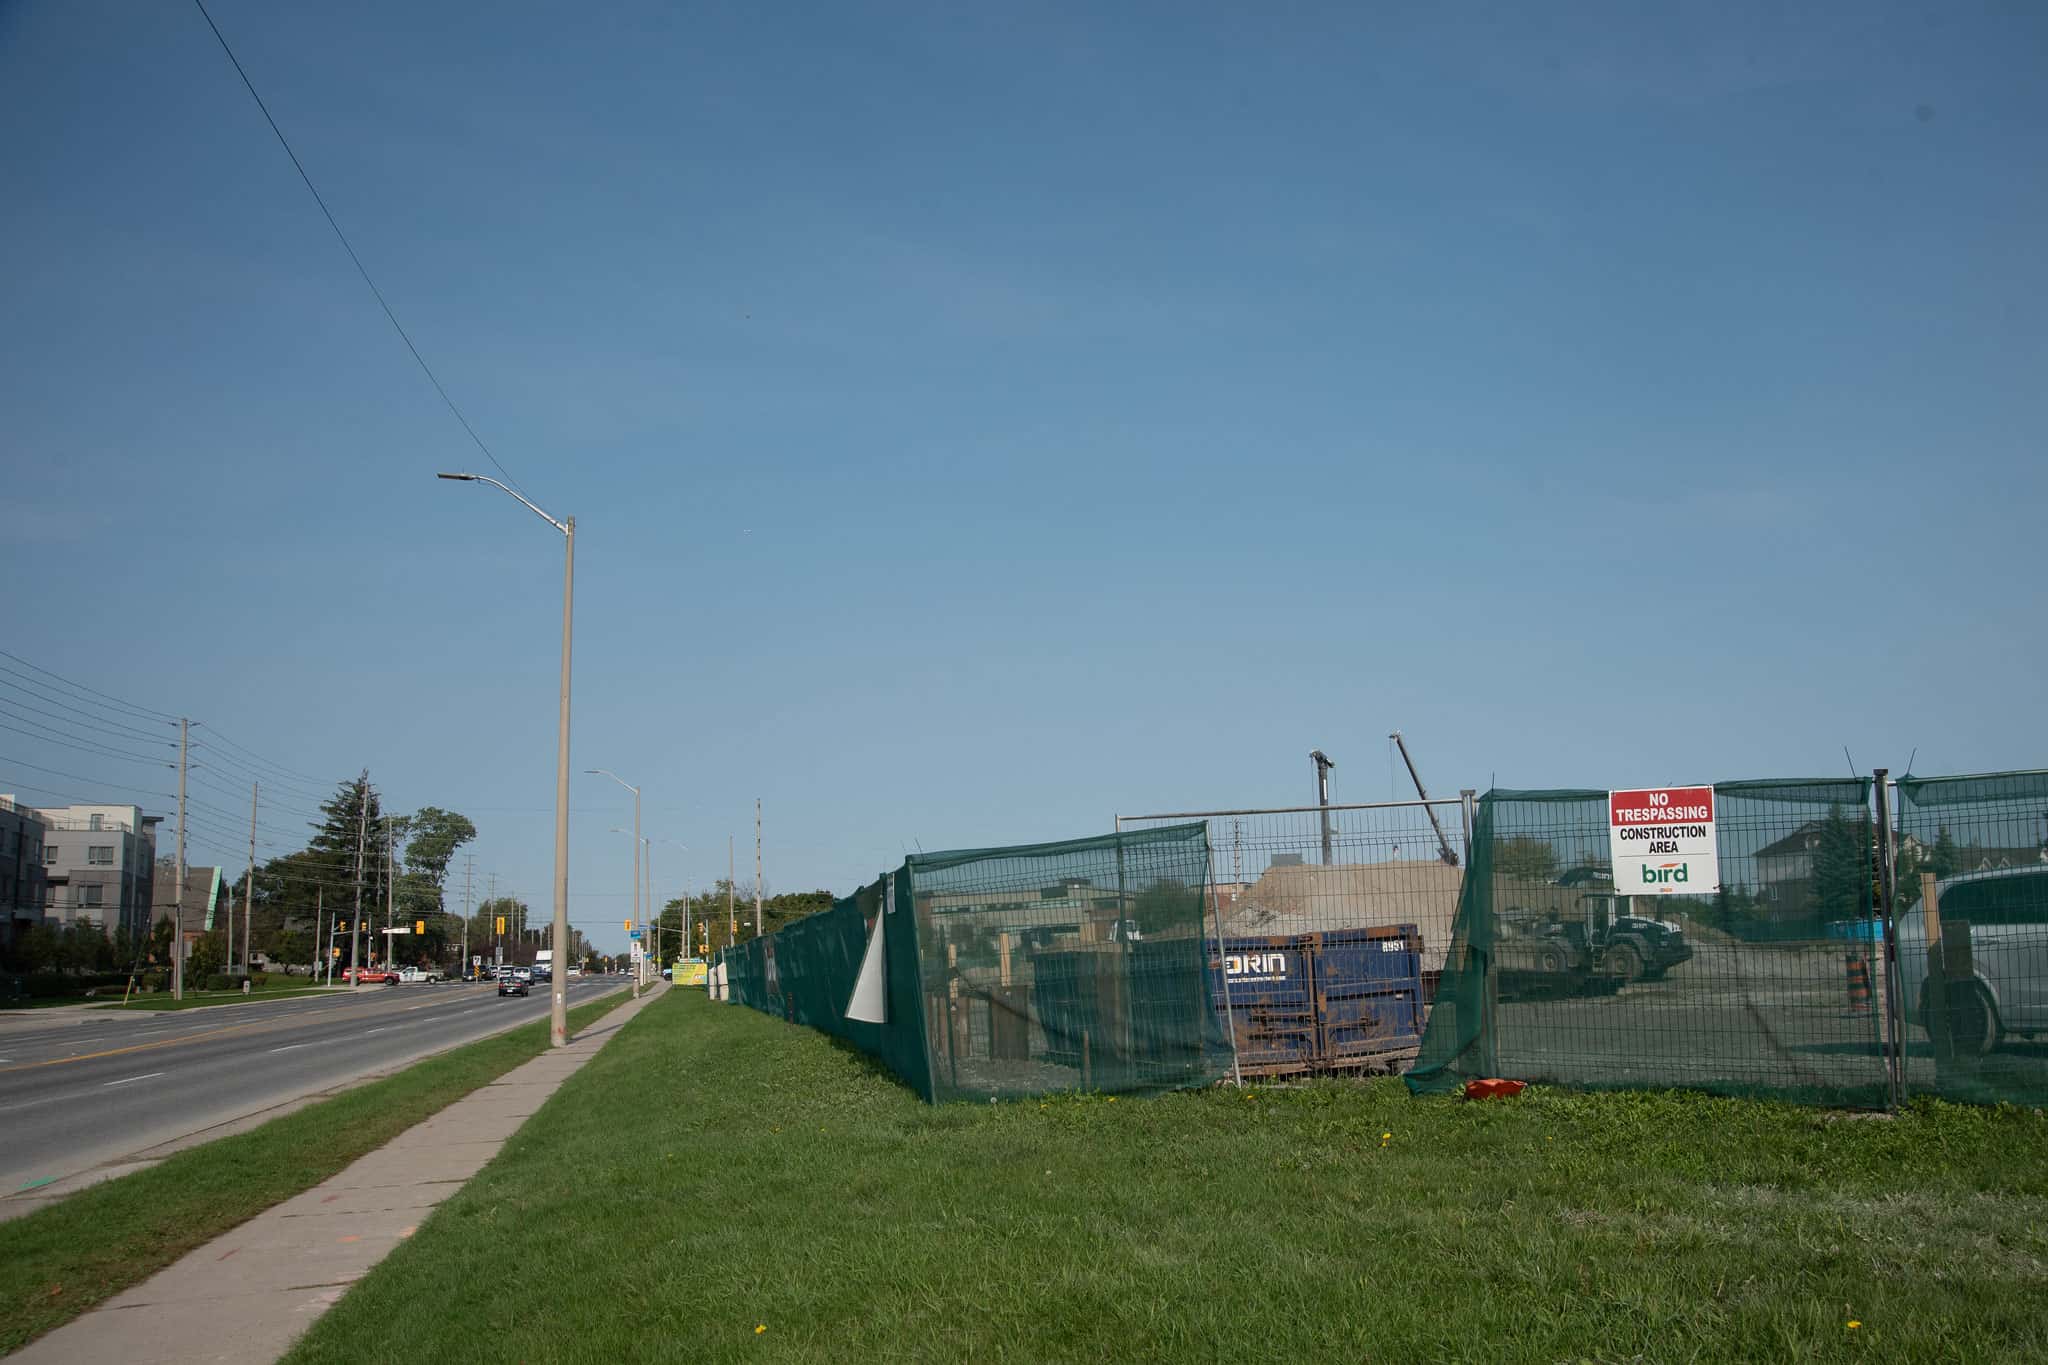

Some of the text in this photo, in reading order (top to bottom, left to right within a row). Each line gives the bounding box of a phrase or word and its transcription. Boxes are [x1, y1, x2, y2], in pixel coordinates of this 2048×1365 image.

[1649, 793, 1669, 807] NO
[1616, 805, 1708, 822] TRESPASSING
[1620, 825, 1706, 841] CONSTRUCTION
[1649, 841, 1679, 854] AREA
[1642, 863, 1688, 883] bird
